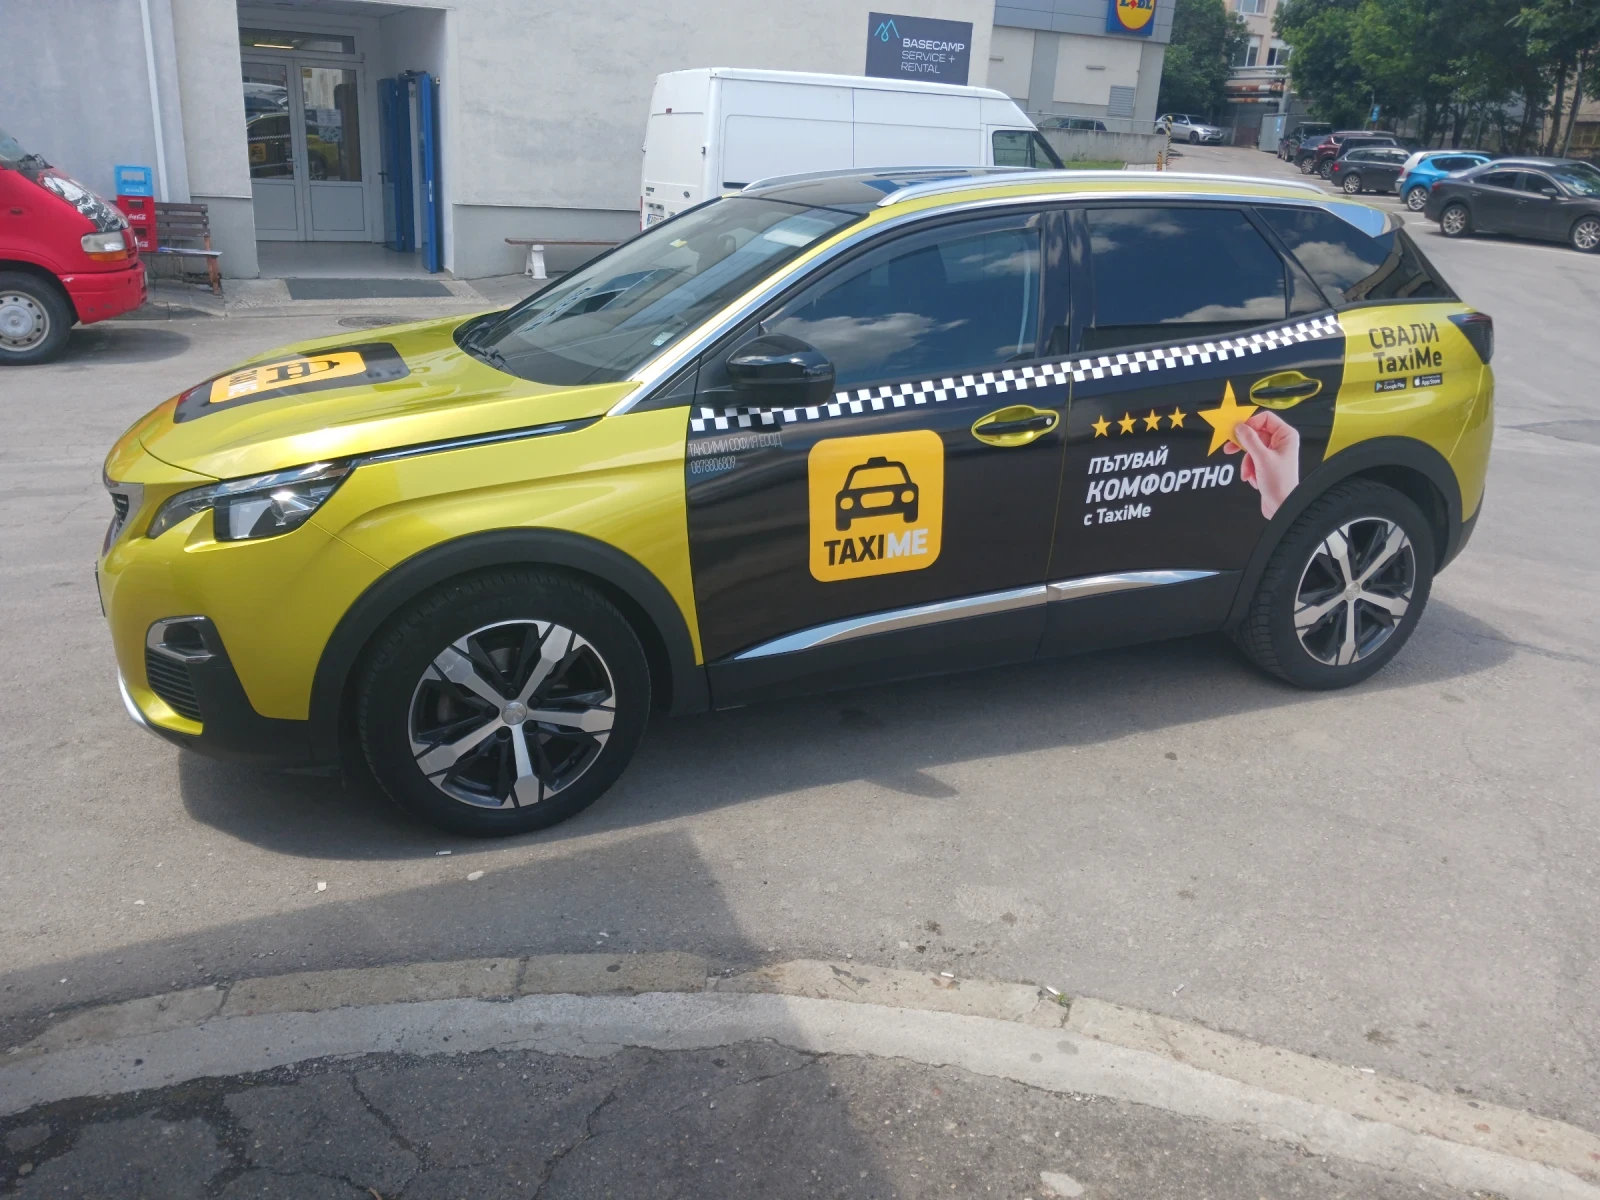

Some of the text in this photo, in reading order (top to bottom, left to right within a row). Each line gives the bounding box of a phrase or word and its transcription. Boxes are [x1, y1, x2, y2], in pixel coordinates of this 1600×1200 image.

[901, 50, 956, 63] SERVICE +
[902, 38, 965, 52] BASECAMP
[900, 61, 941, 74] RENTAL
[1368, 322, 1440, 349] СВАЛИ
[1373, 346, 1442, 374] TaxiMe
[687, 432, 783, 457] ТАКСИМИ СОФИЯ ЕООД
[1088, 446, 1169, 475] ПЪТУВАЙ
[1085, 463, 1235, 504] КОМФОРТНО
[1096, 502, 1152, 525] TaxiMe
